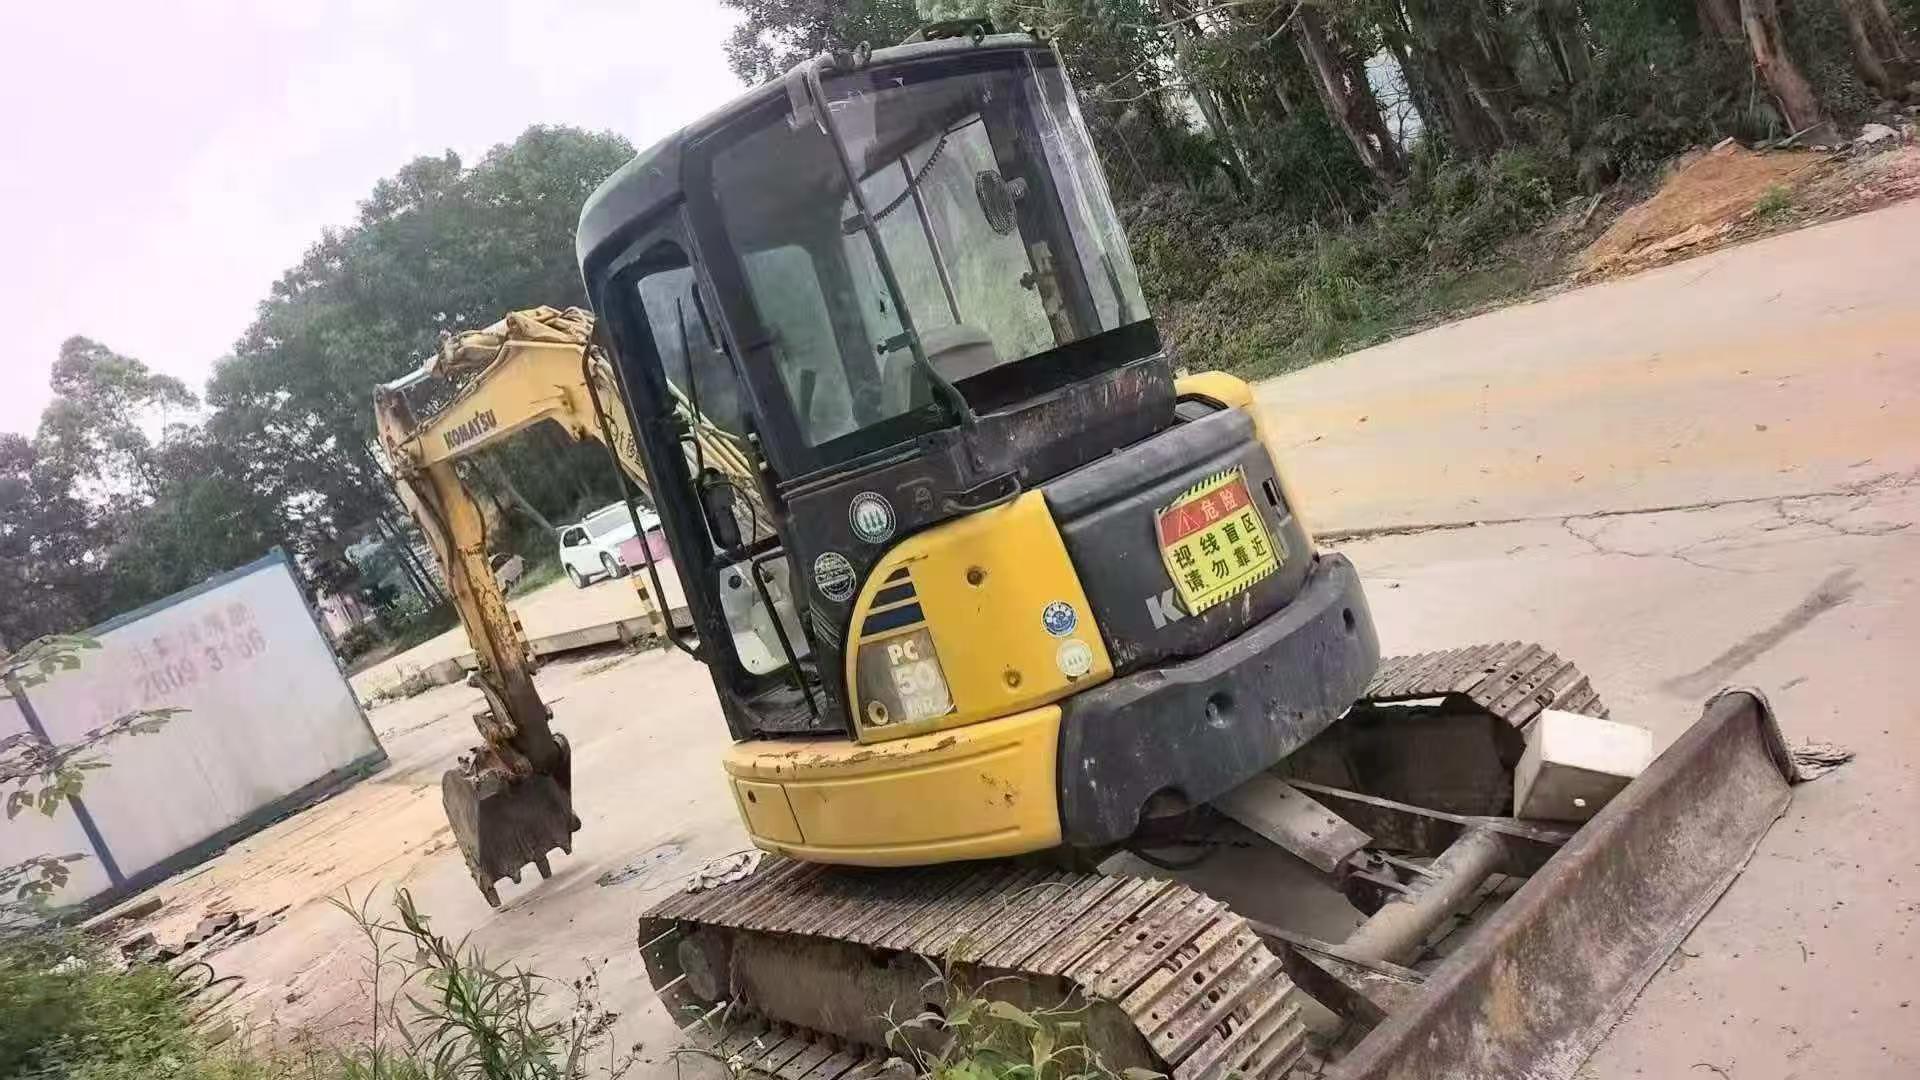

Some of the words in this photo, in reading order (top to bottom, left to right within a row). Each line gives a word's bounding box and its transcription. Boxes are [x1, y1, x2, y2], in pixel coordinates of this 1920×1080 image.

[443, 409, 498, 450] KOMATSU
[1200, 489, 1239, 520] 危险
[1173, 512, 1257, 570] 视线盲区
[1184, 535, 1267, 593] 请勿靠近
[888, 641, 919, 664] PC
[895, 661, 936, 694] 50
